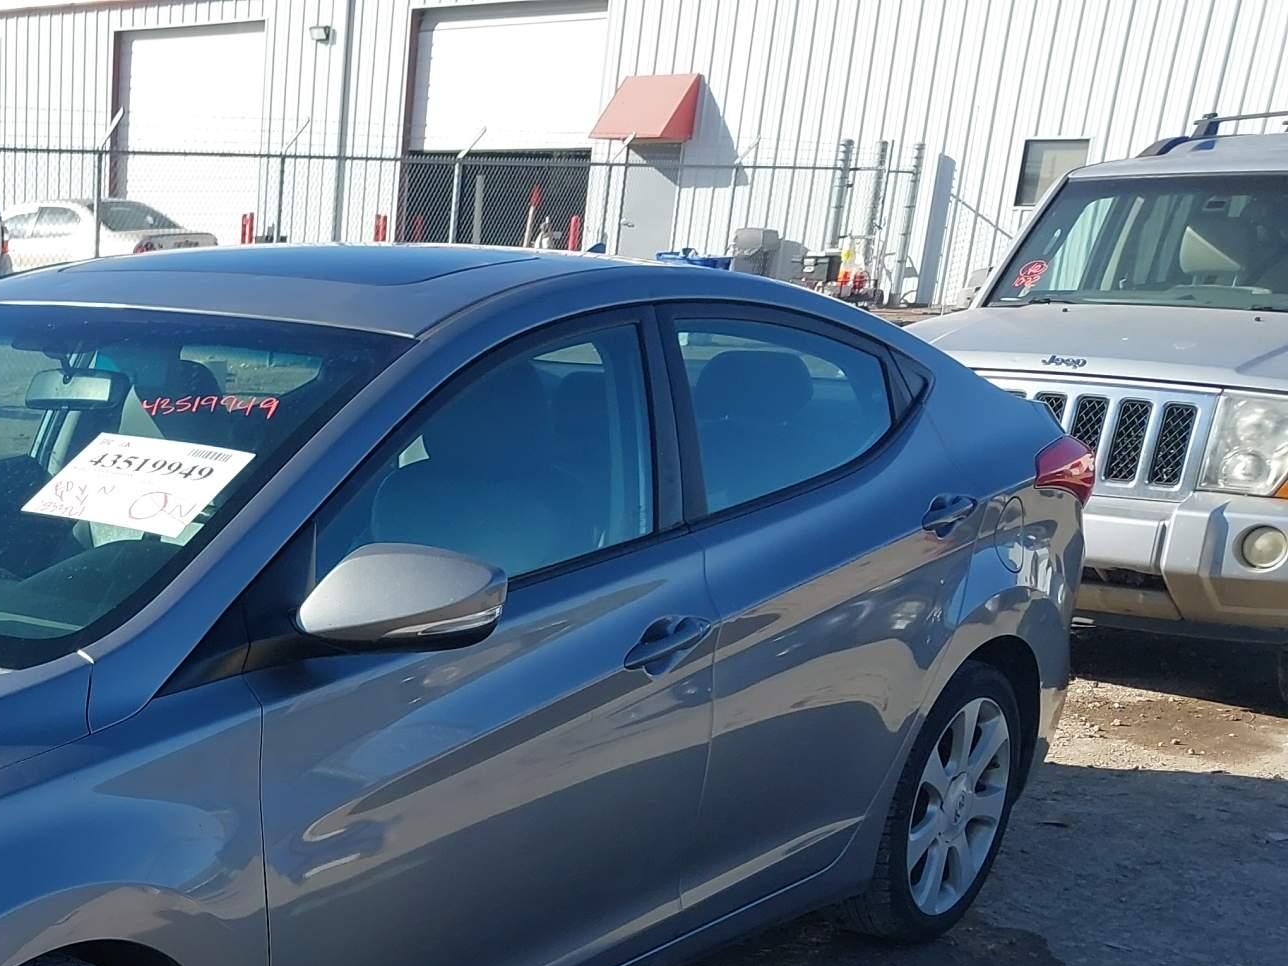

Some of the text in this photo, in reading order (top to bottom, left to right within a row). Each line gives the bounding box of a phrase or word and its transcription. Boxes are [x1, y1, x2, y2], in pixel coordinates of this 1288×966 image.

[1041, 355, 1087, 369] Jeep
[142, 395, 280, 420] 43519949
[90, 452, 215, 481] 43519949
